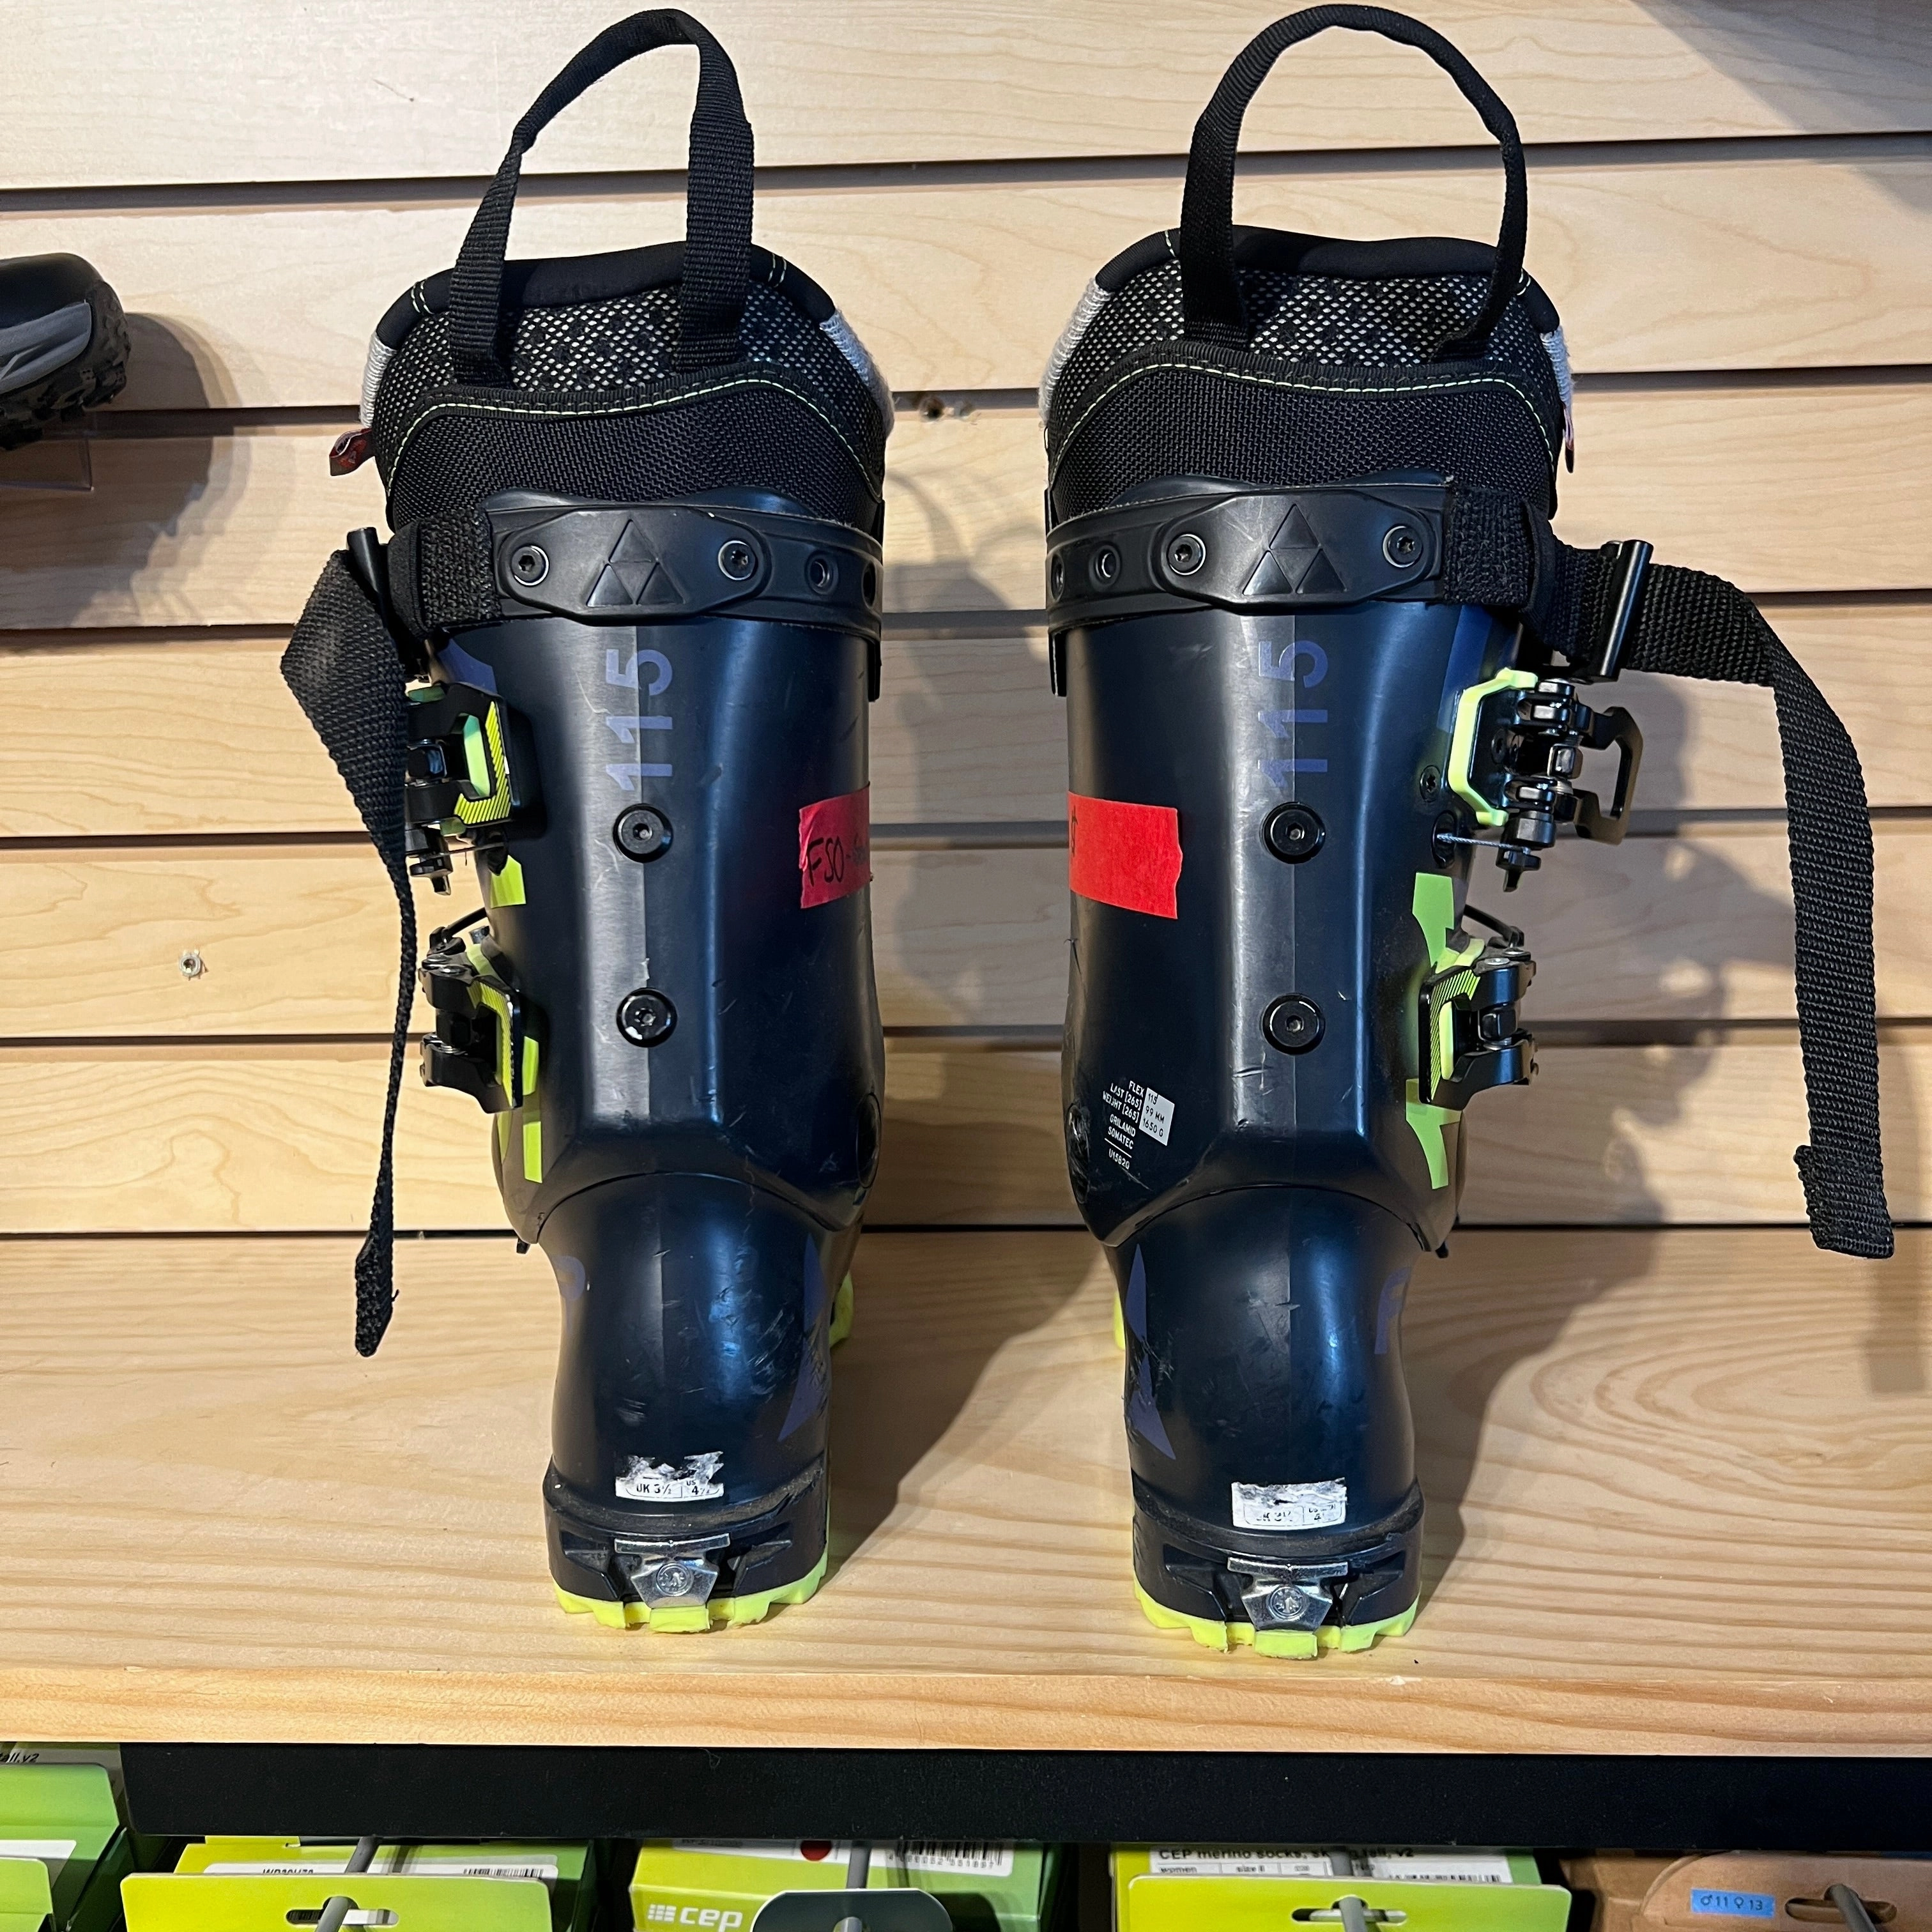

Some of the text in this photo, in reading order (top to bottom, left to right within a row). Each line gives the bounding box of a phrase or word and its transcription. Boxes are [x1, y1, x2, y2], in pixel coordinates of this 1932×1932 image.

[606, 649, 673, 790] 115
[1258, 641, 1328, 787] 115
[1110, 1083, 1165, 1124] LAST [265] 99 MM
[1128, 1080, 1159, 1105] FLEX 115
[1109, 1114, 1136, 1137] GRILAMID
[1122, 1103, 1140, 1124] [265]
[1143, 1118, 1158, 1133] 1650
[1159, 1128, 1164, 1137] G
[1107, 1126, 1134, 1150] SOMATEC
[636, 1483, 650, 1494] UK
[1159, 1849, 1191, 1860] CEP
[1197, 1849, 1252, 1859] merino
[679, 1906, 744, 1932] cep
